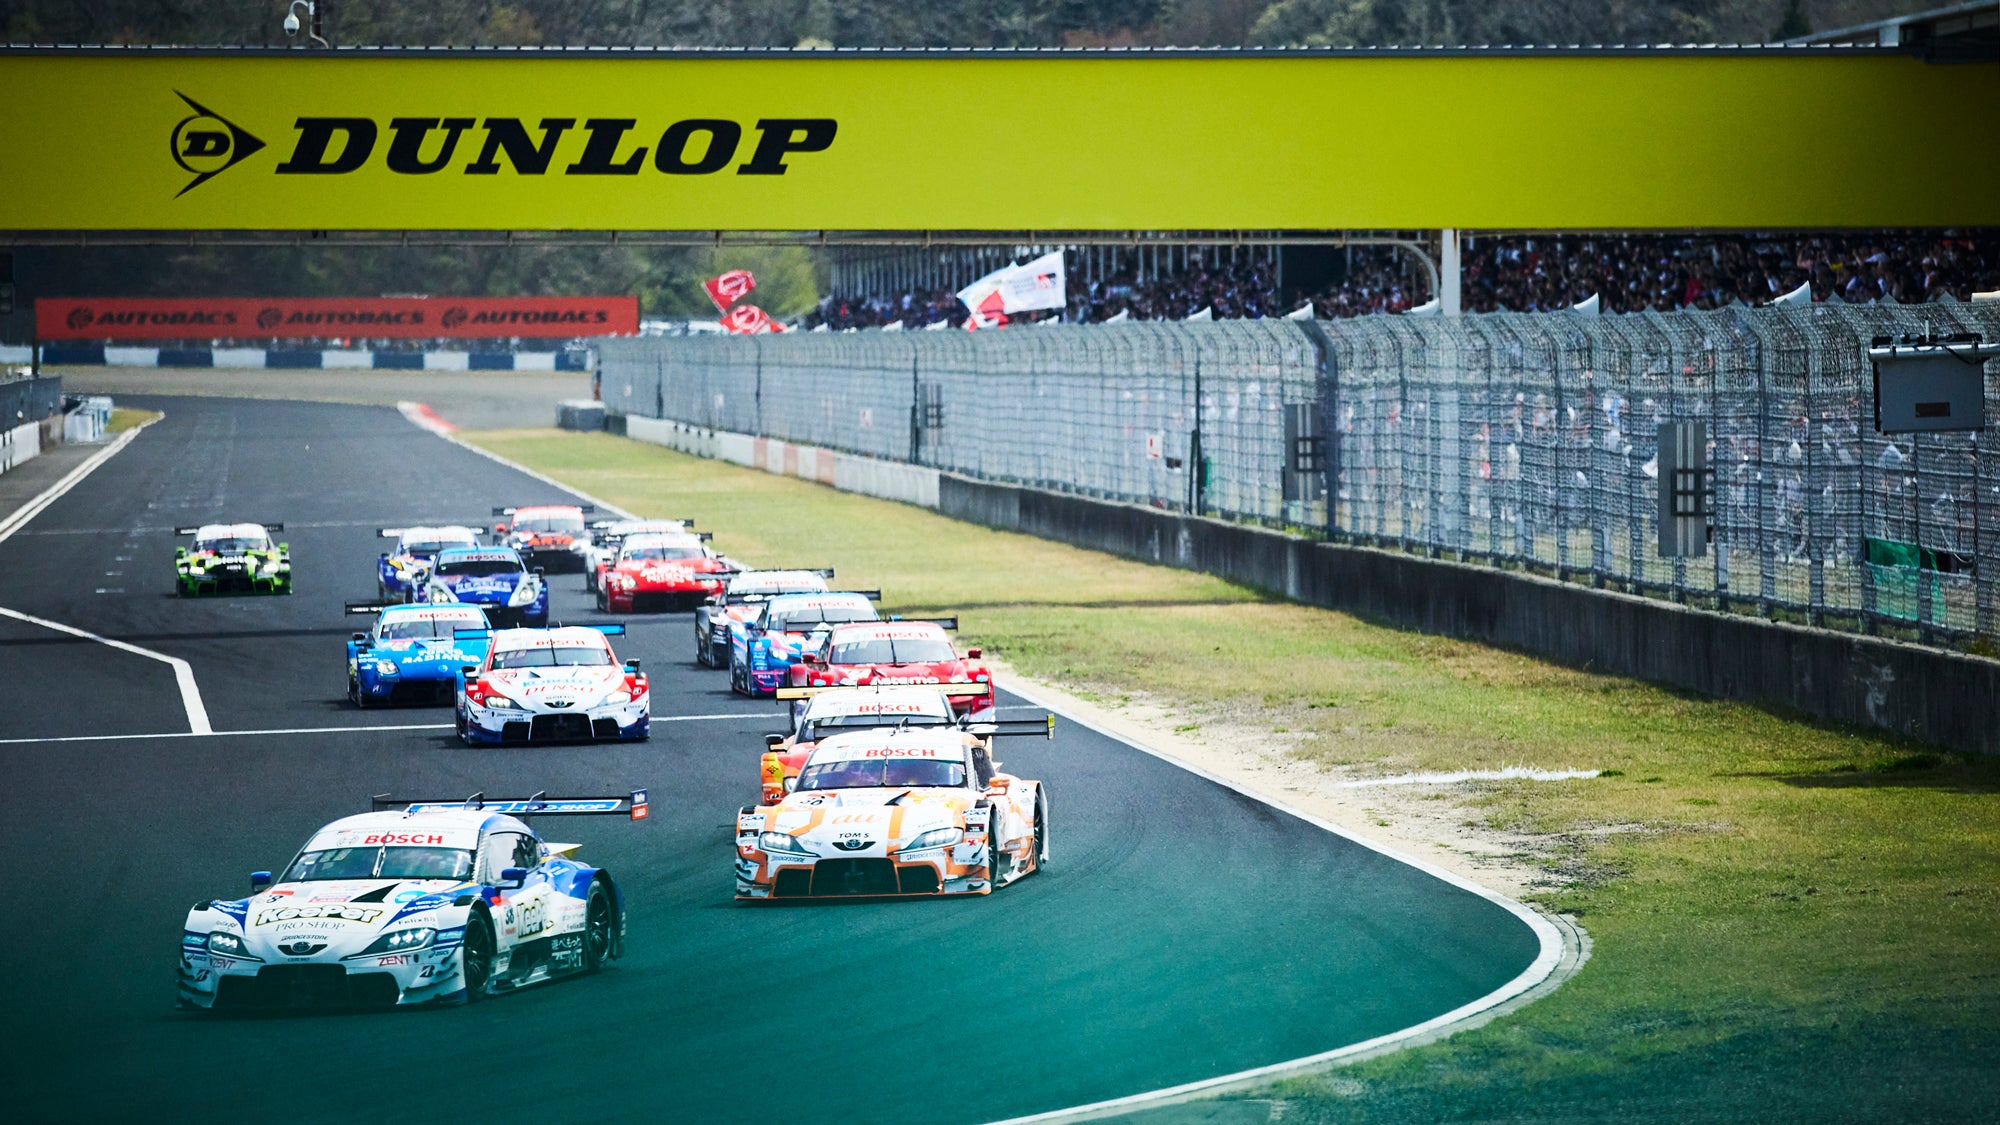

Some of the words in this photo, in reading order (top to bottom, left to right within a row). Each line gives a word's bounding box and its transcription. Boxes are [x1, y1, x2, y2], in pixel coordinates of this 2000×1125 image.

[274, 117, 838, 175] DUNLOP
[96, 310, 238, 326] AUTOBACS
[287, 310, 424, 325] AUTOBACS
[471, 310, 608, 325] AUTOBACS
[528, 535, 574, 546] ARTA
[467, 554, 506, 562] BOSCH
[875, 631, 930, 639] BOSCH
[402, 653, 481, 663] RADIATOR
[871, 675, 940, 685] Astemo
[525, 684, 594, 696] DENSO
[858, 705, 921, 713] BOSCH
[865, 748, 935, 758] BOSCH
[364, 834, 443, 845] BOSCH
[256, 904, 384, 927] KeePer
[275, 921, 303, 932] PRO
[307, 920, 346, 931] SHOP
[378, 953, 412, 967] ZENT
